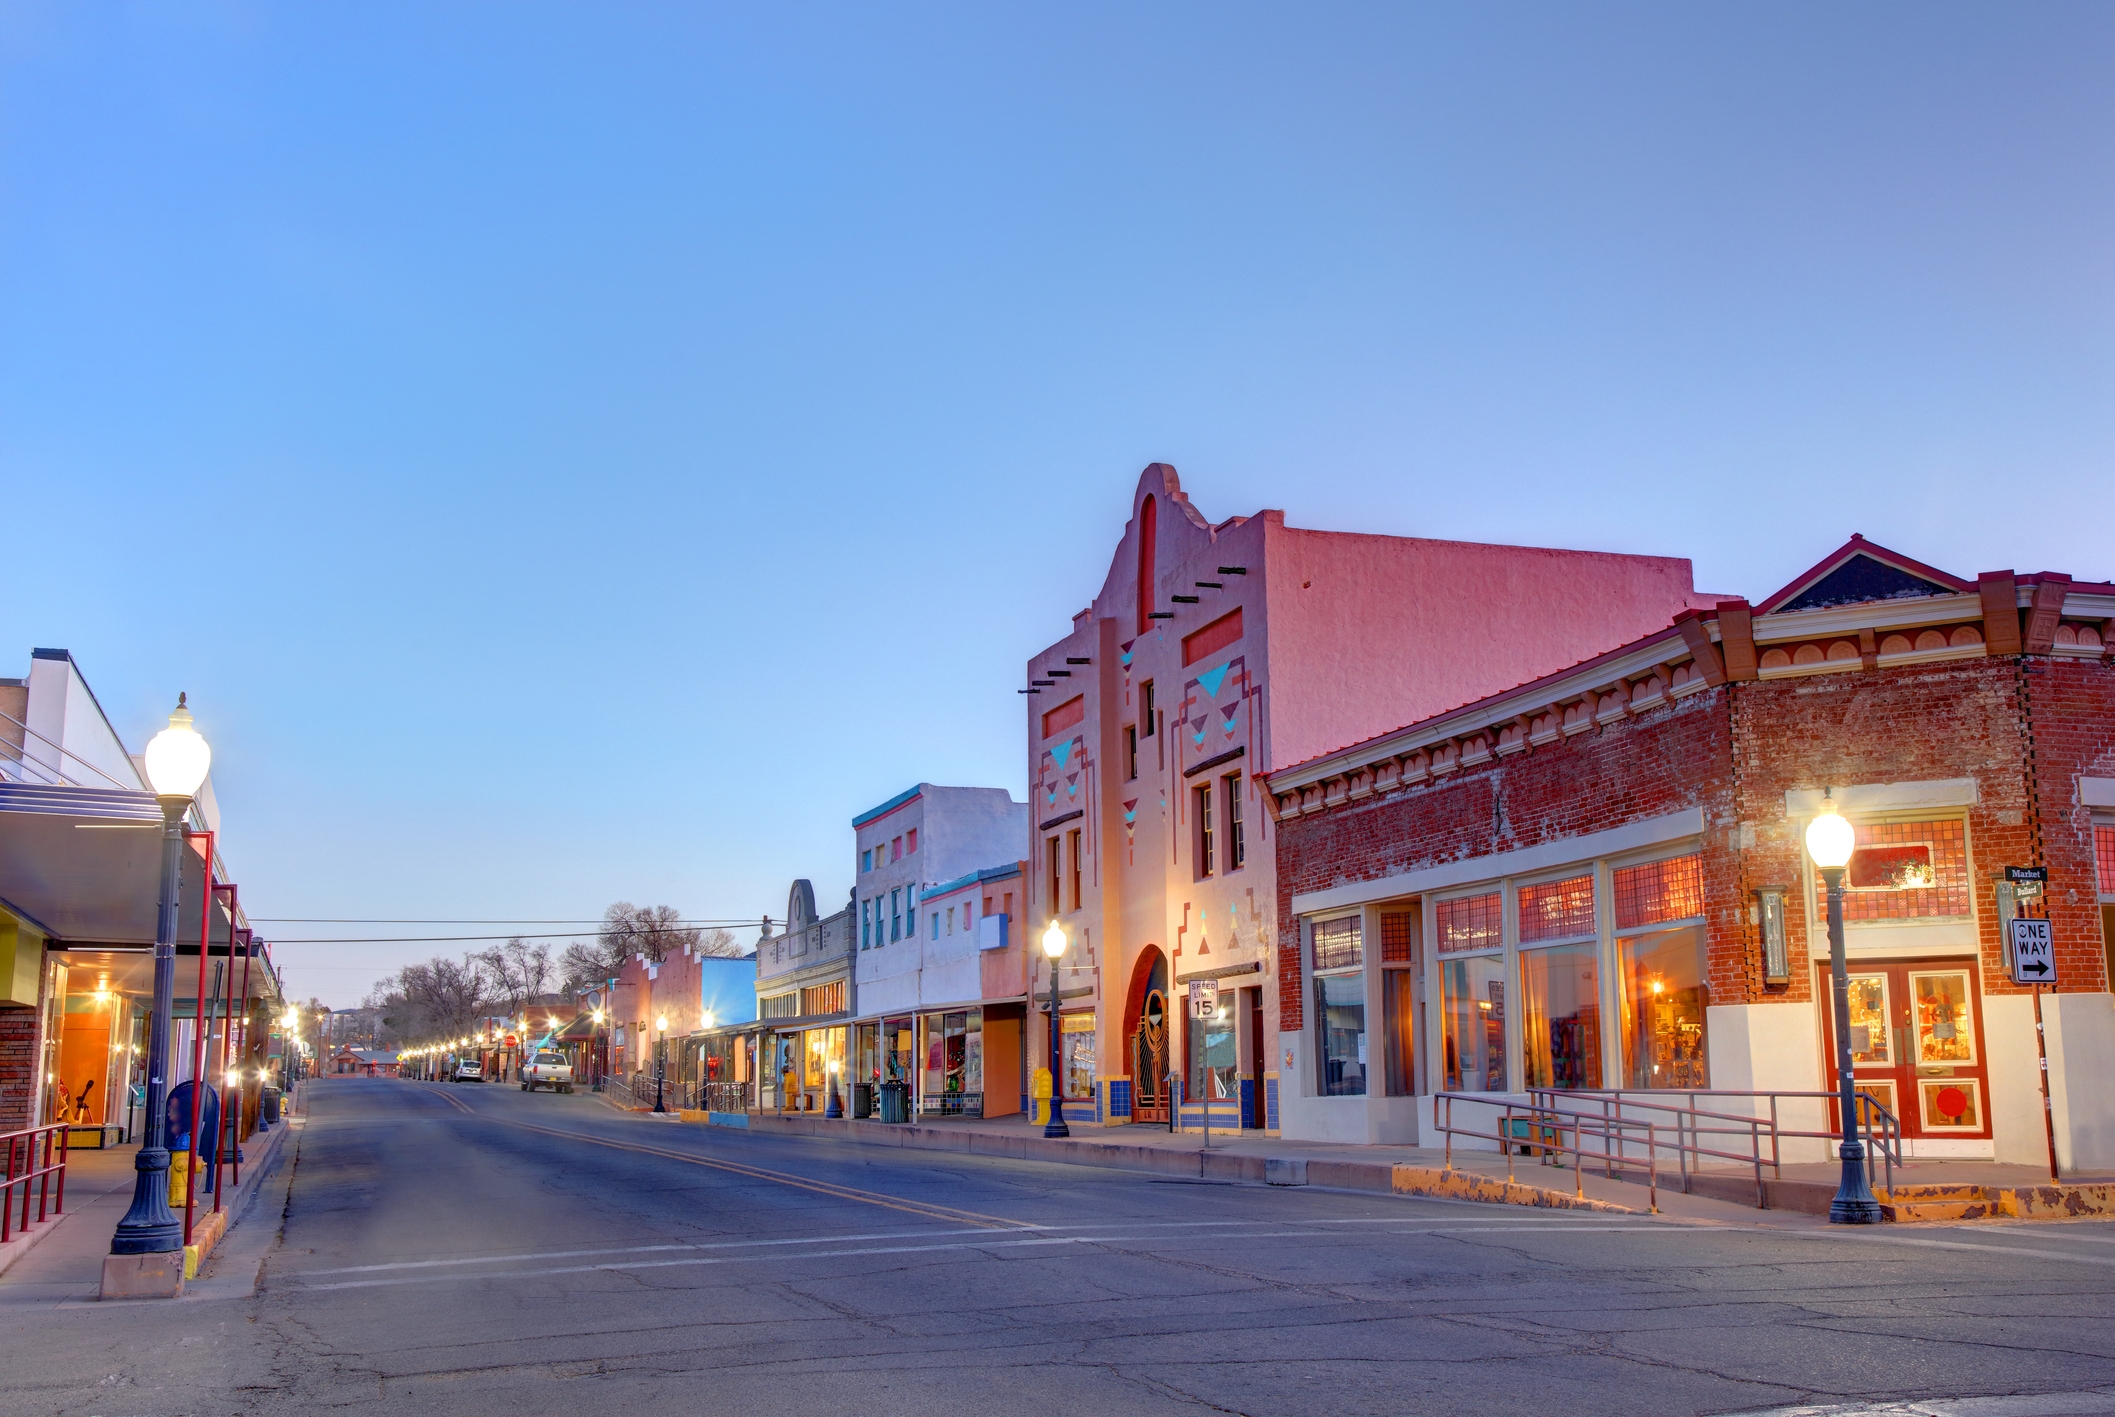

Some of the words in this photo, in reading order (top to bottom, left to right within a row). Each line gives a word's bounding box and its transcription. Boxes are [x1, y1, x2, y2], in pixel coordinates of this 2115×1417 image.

[2011, 869, 2041, 879] Market
[2017, 885, 2037, 897] Bullard
[2018, 924, 2047, 939] ONE
[2018, 941, 2048, 955] WAY
[1195, 1001, 1213, 1016] 15
